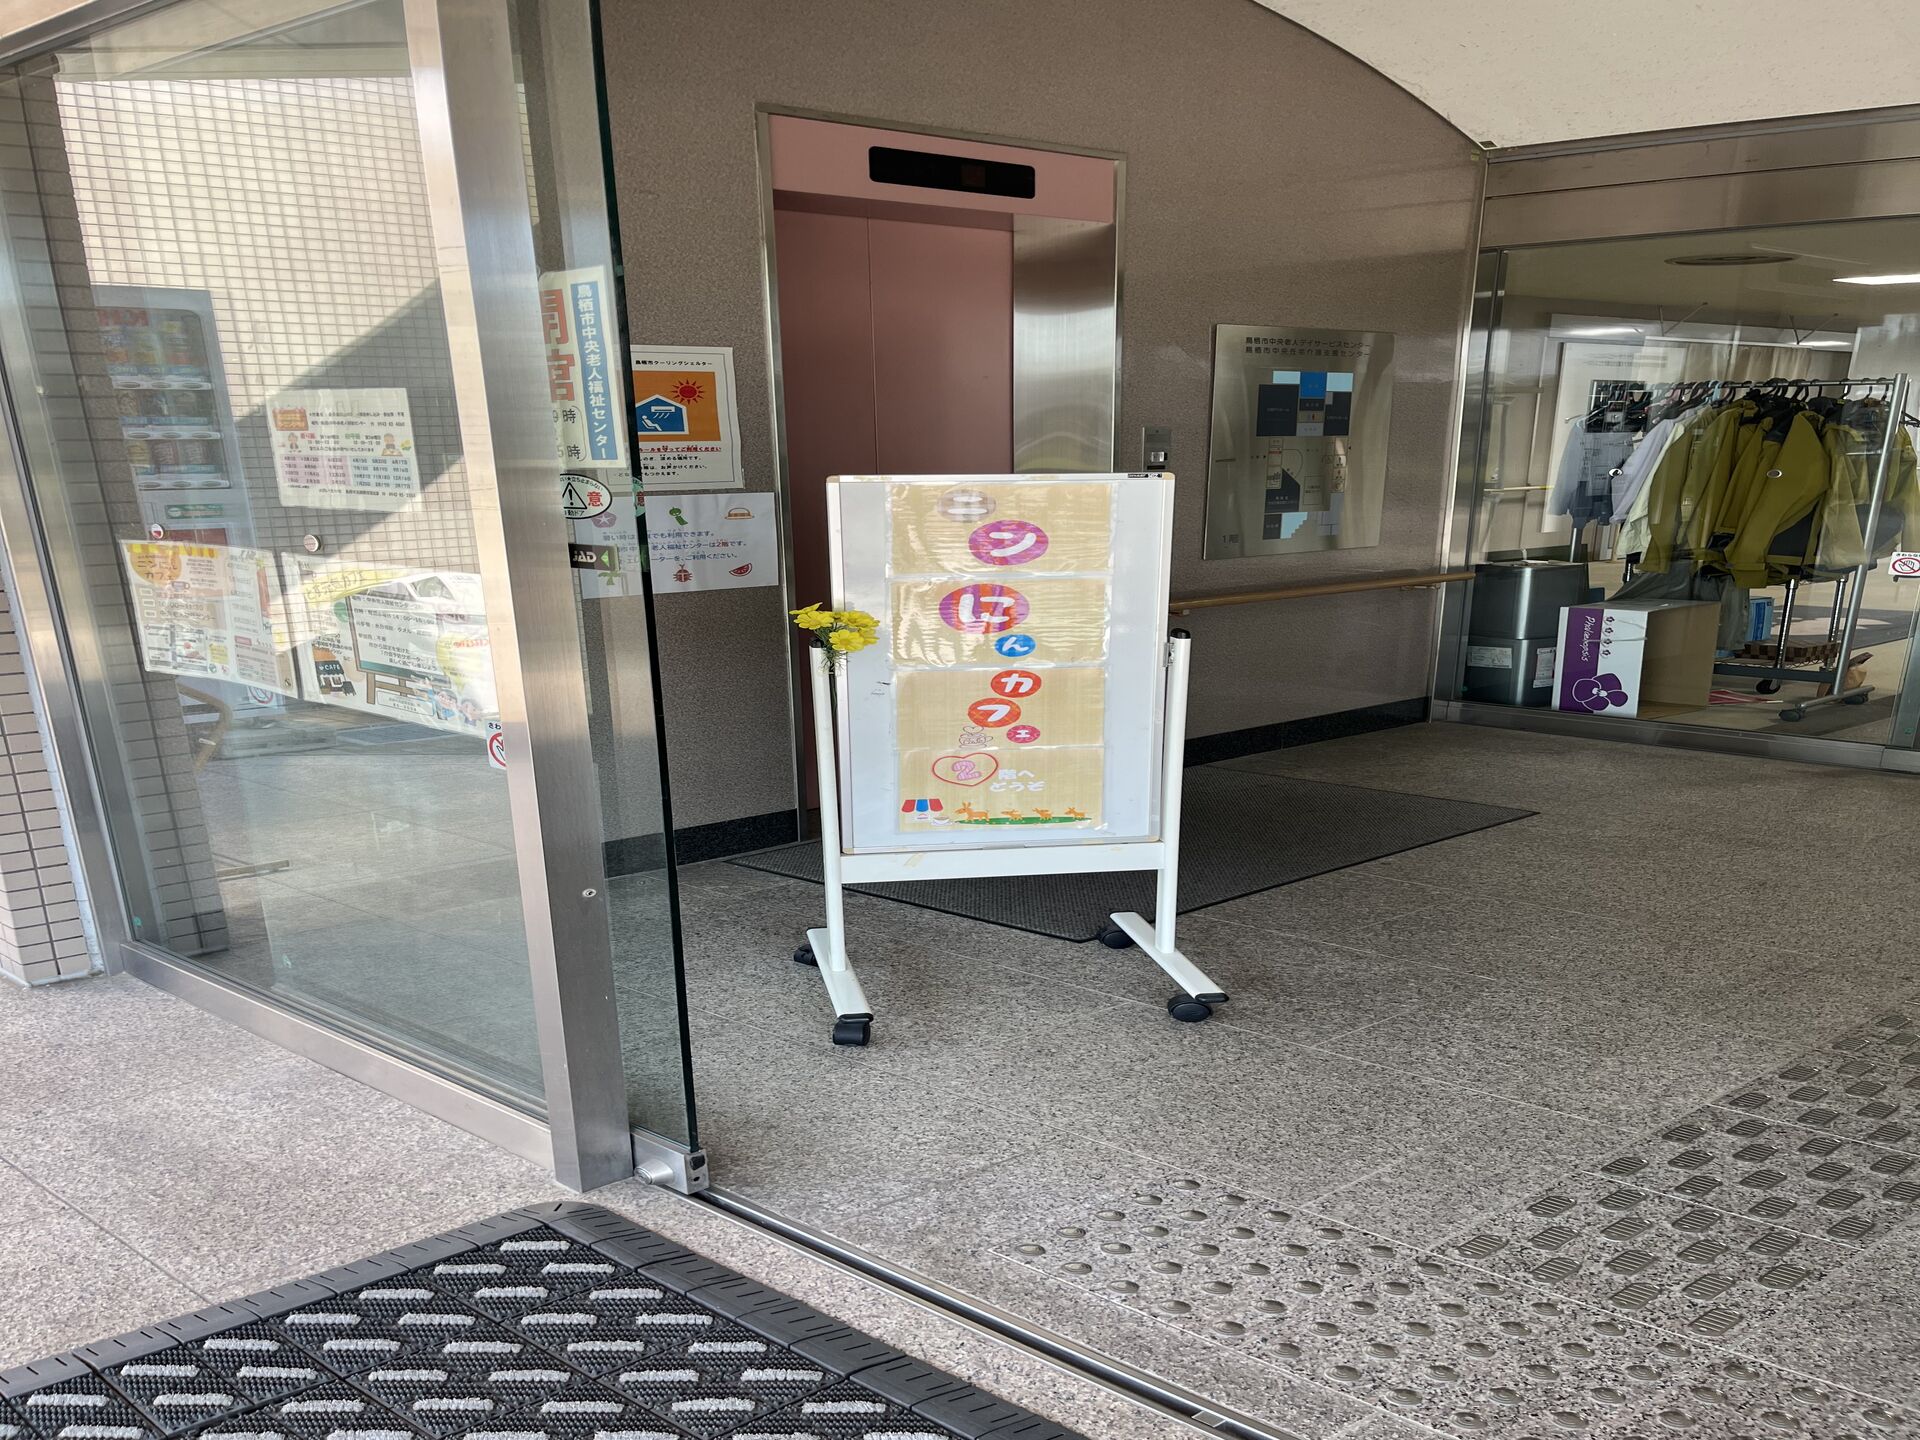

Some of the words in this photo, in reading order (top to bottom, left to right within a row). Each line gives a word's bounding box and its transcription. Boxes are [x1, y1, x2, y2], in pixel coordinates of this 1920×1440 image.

[576, 284, 609, 459] 鳥栖市中央老人福祉センター
